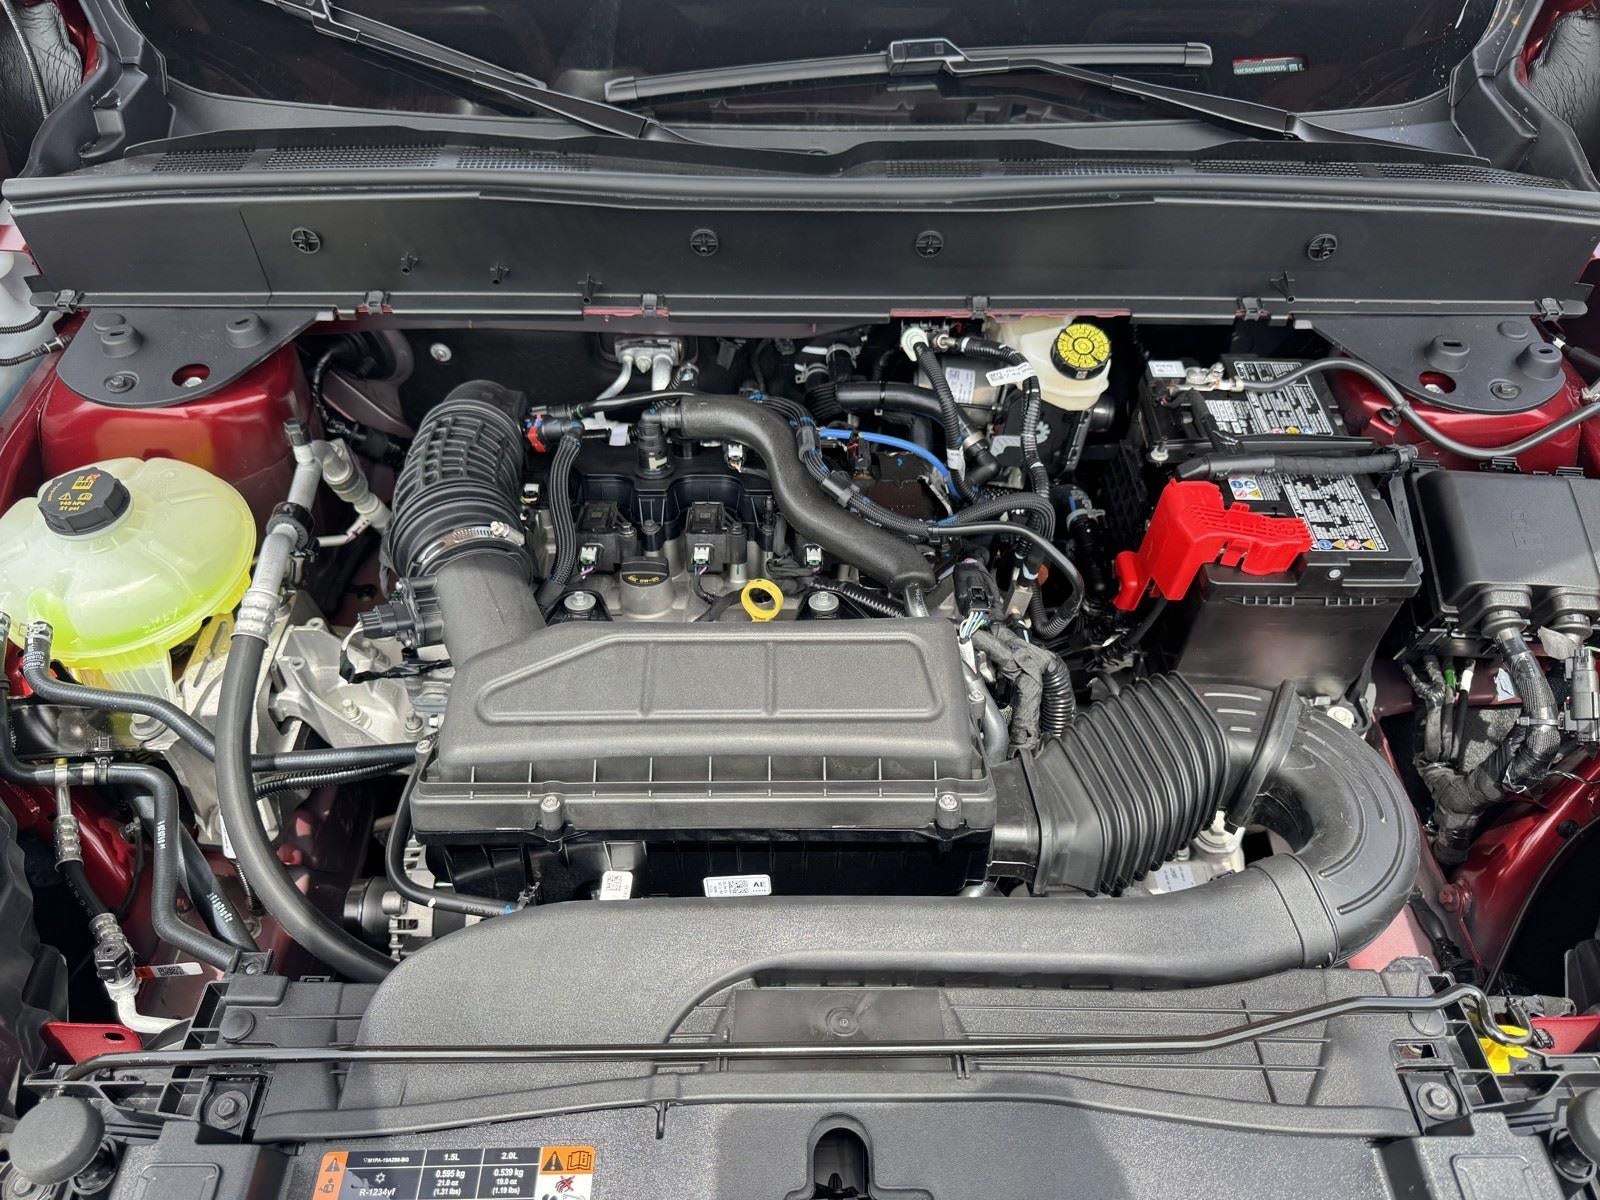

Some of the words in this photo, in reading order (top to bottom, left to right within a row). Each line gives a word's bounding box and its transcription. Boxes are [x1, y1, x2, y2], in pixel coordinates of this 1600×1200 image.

[443, 1153, 460, 1161] 1.5L
[501, 1152, 518, 1160] 2.0L
[435, 1169, 456, 1178] 0.595
[456, 1169, 466, 1179] kg
[493, 1168, 514, 1177] 0.539
[514, 1168, 524, 1178] kg
[359, 1187, 397, 1197] R-1234yf
[433, 1188, 449, 1197] (1.31
[449, 1188, 462, 1197] lbs)
[492, 1187, 508, 1196] (1.19
[508, 1187, 520, 1196] lbs)
